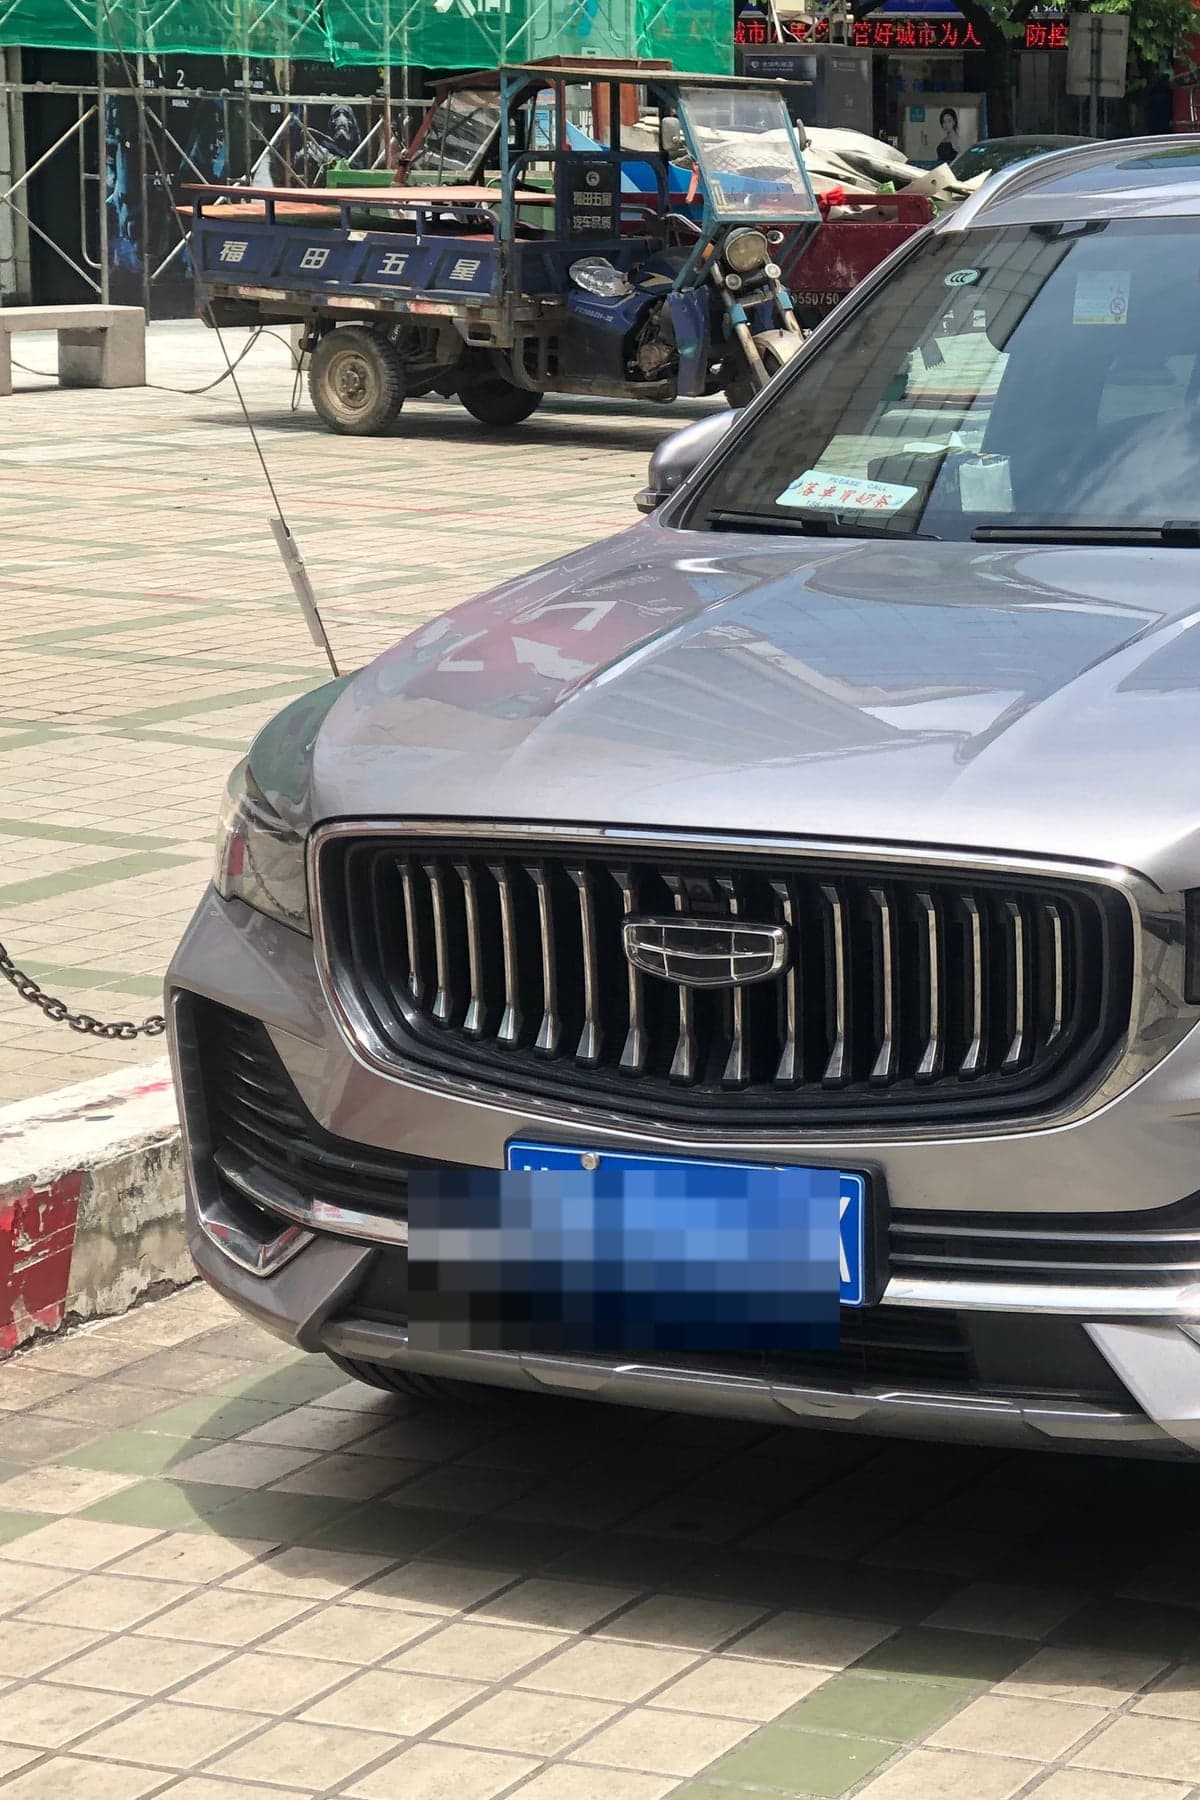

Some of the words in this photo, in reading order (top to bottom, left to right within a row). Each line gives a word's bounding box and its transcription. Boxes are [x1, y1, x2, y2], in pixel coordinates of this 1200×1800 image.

[853, 21, 982, 47] 管好城市为人
[1025, 23, 1070, 47] 防控
[176, 70, 185, 87] 2
[573, 191, 613, 207] 福田五星
[219, 240, 481, 282] 福田五星
